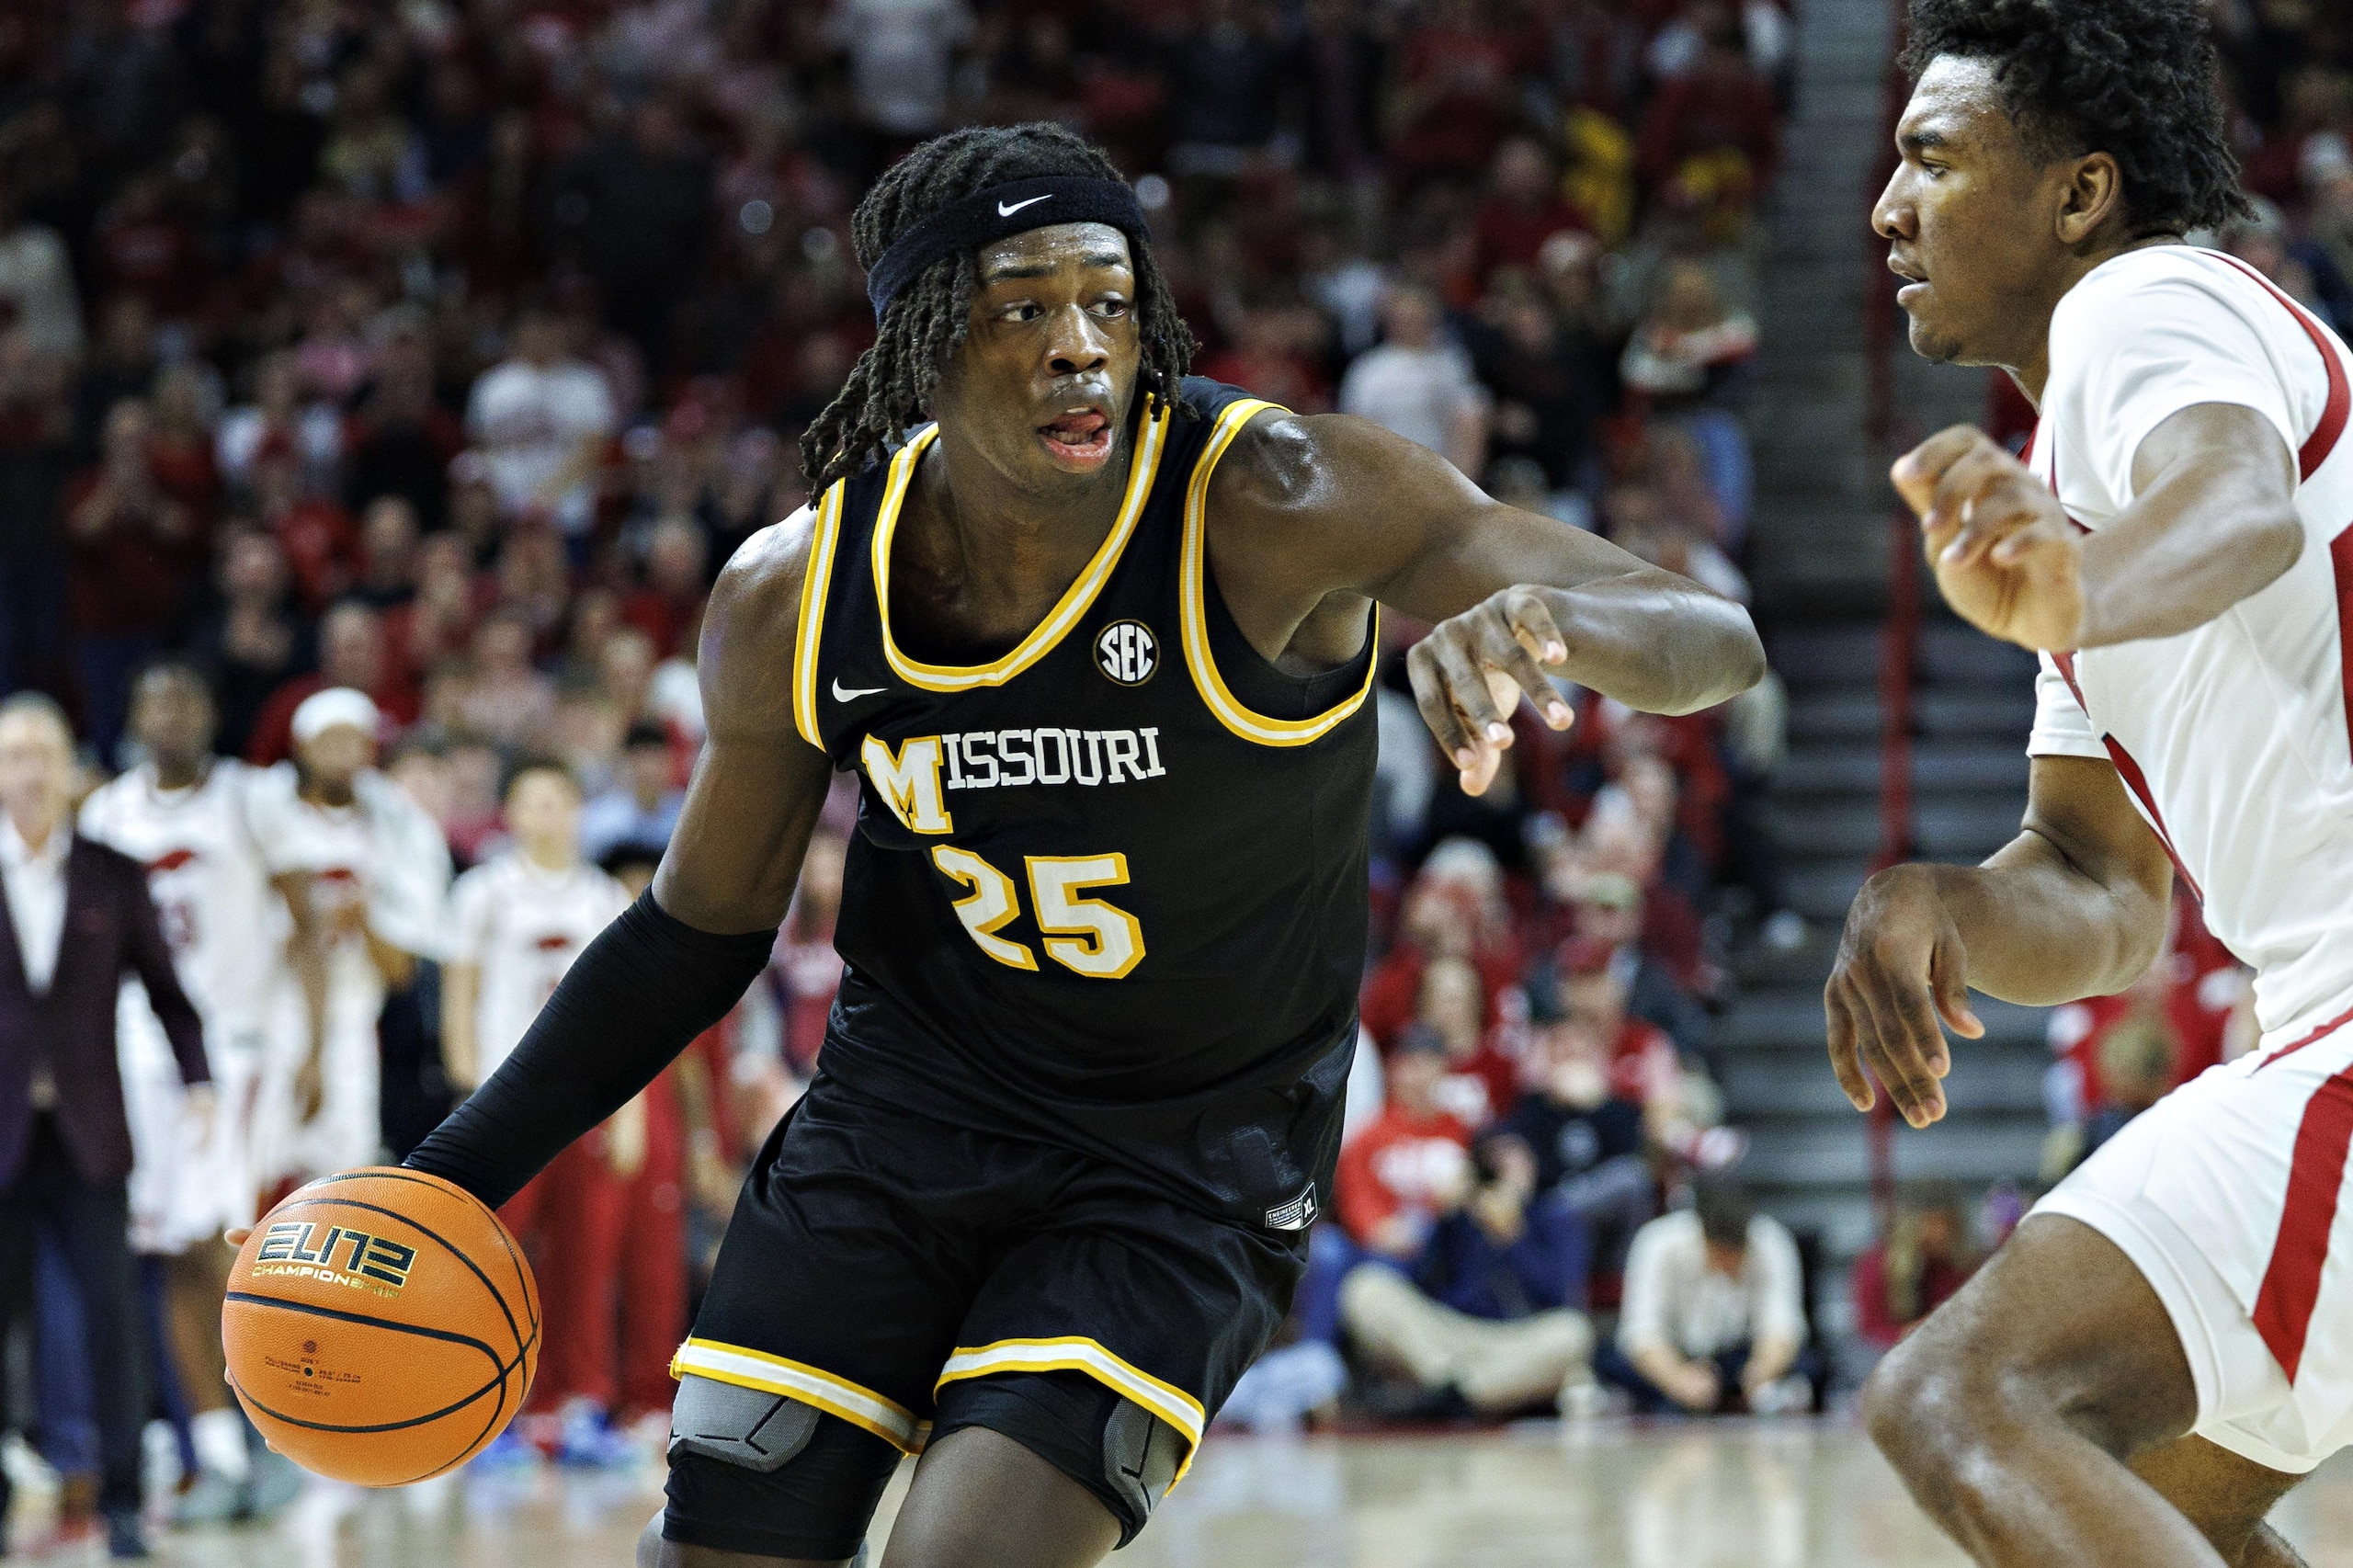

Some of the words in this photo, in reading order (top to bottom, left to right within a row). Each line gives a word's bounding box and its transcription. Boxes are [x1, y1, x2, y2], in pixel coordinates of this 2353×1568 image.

[1098, 623, 1154, 682] SEC
[860, 727, 1166, 835] MISSOURI
[931, 844, 1146, 980] 25
[1303, 1198, 1314, 1218] XL
[256, 1221, 418, 1289] ELITE
